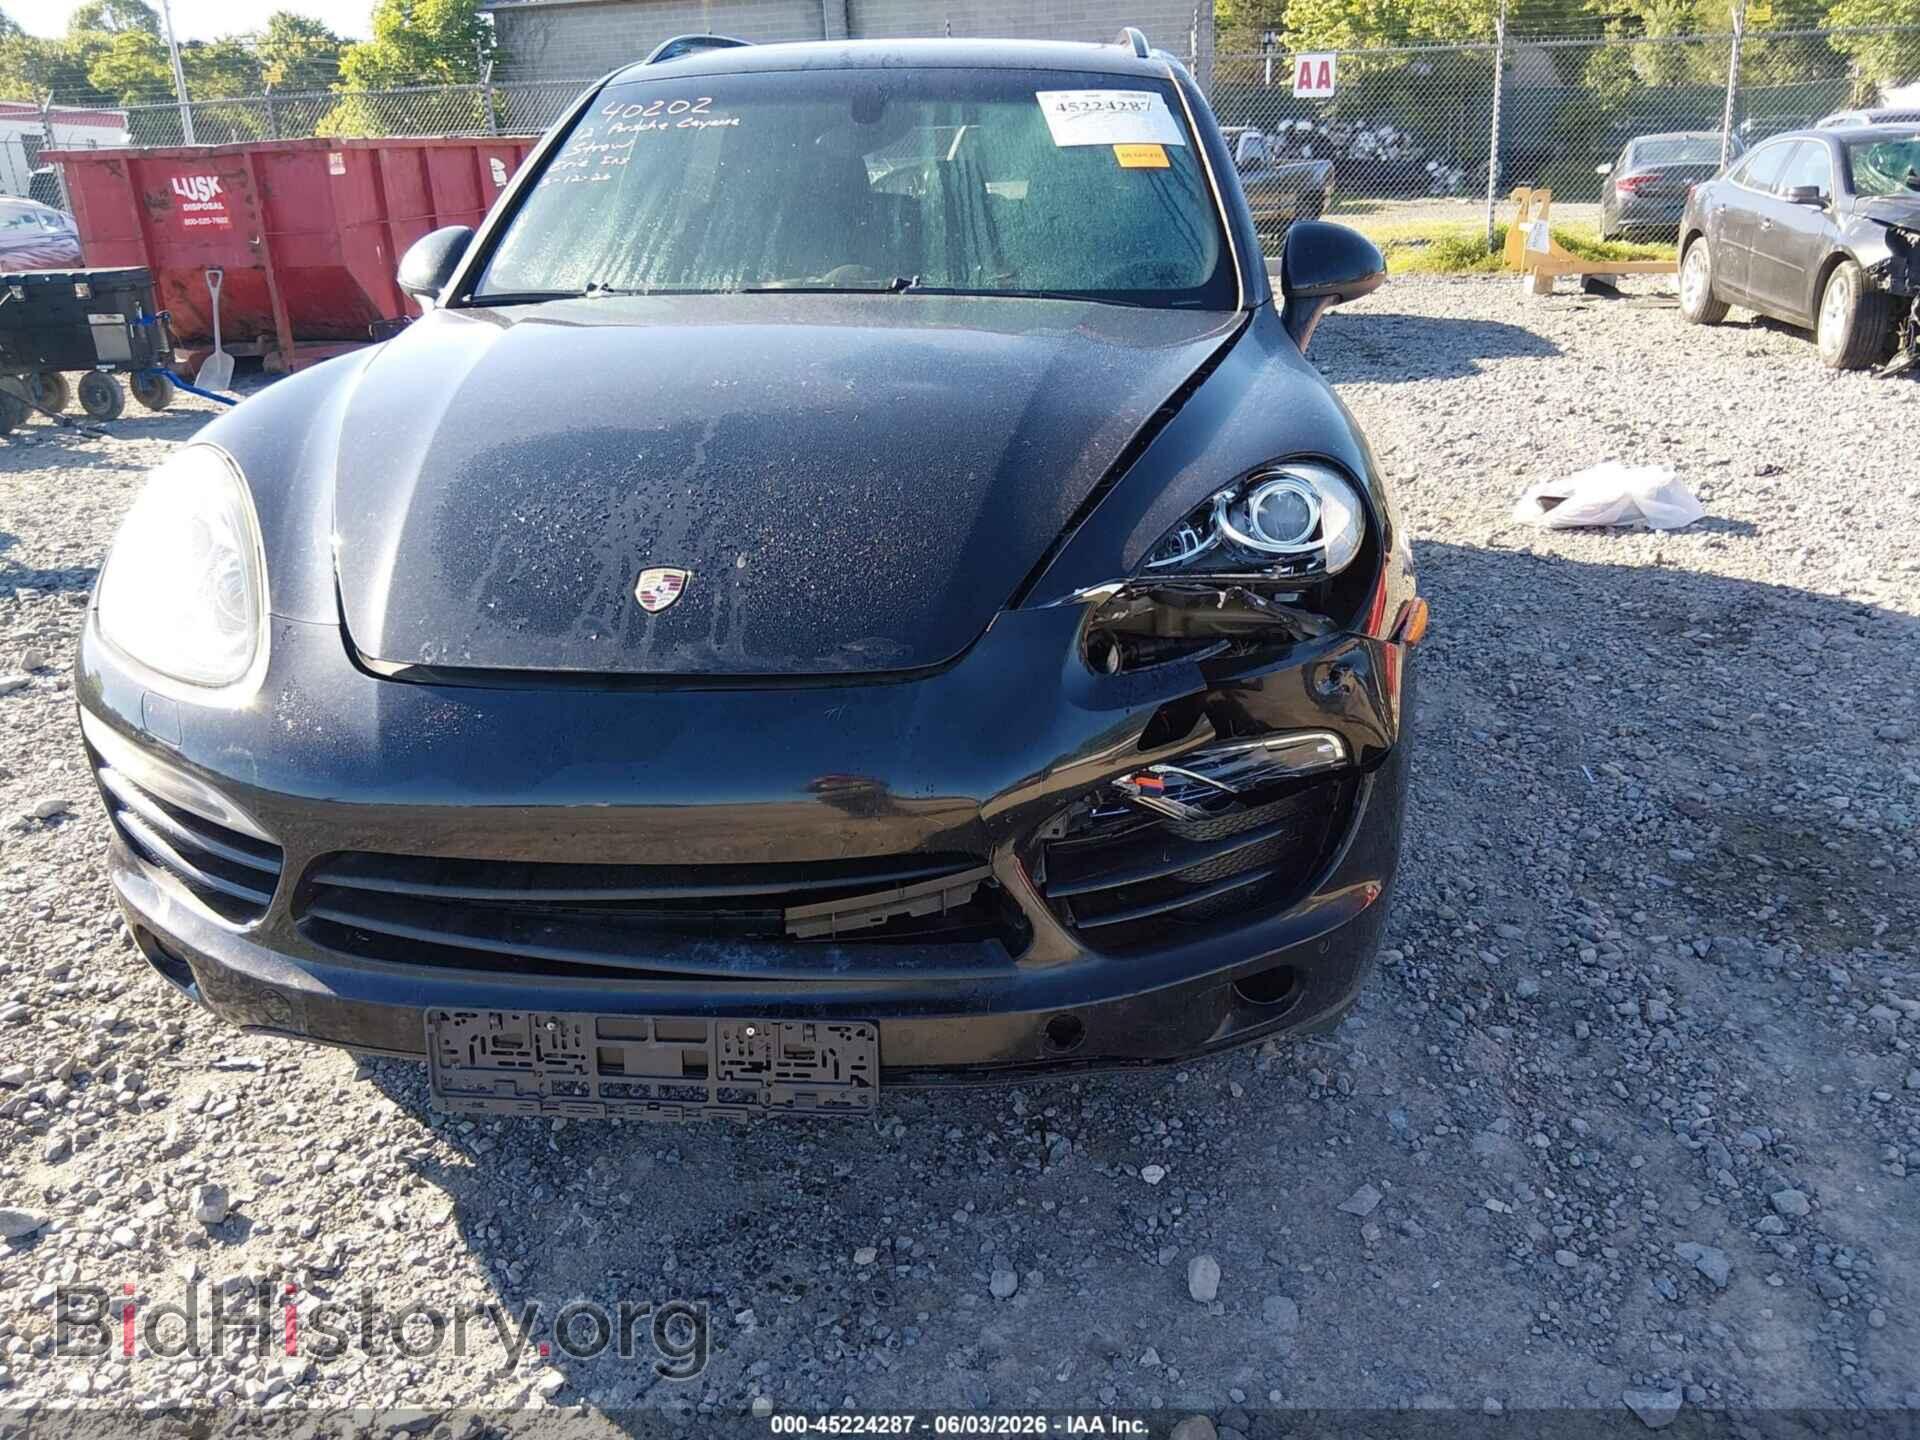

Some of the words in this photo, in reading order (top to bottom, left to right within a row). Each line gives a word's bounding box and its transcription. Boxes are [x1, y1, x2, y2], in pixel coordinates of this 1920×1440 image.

[1297, 61, 1331, 89] AA
[602, 97, 712, 122] 40202
[1055, 101, 1152, 113] 45224287
[171, 176, 223, 202] LUSK
[183, 202, 224, 211] DISPOSAL
